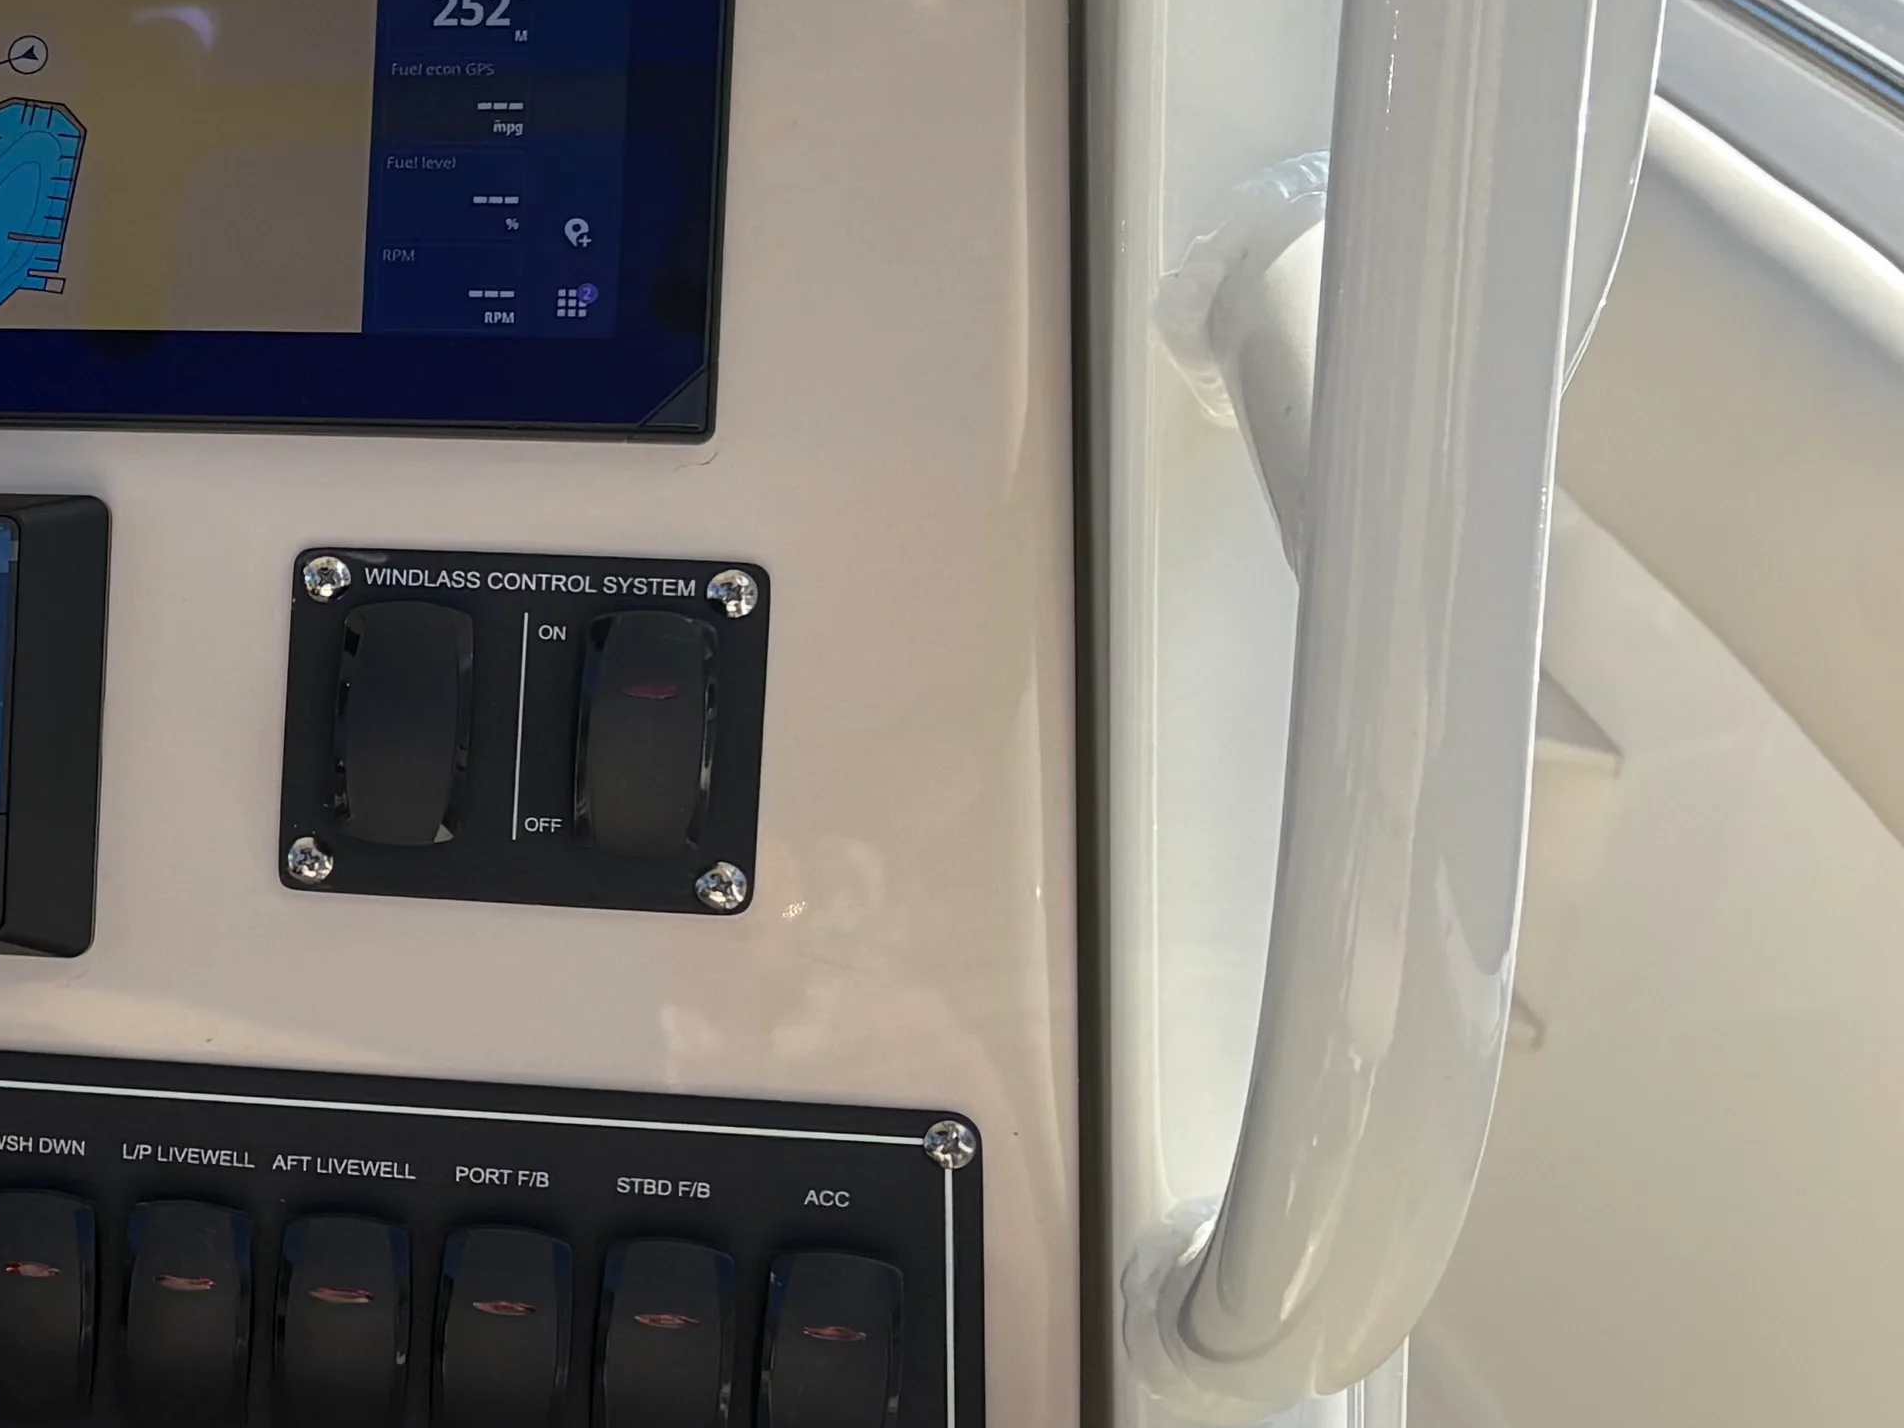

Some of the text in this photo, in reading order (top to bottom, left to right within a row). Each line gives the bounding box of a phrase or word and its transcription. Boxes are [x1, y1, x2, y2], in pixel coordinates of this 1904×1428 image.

[514, 29, 528, 42] M
[391, 61, 495, 78] Fuel econ GPS
[492, 122, 524, 137] mpg
[386, 155, 457, 170] Fuel level
[504, 216, 520, 231] %
[381, 248, 416, 262] RPM
[581, 286, 592, 301] 2
[483, 311, 515, 325] RPM
[365, 567, 696, 598] WINDLASS CONTROL SYSTEM
[538, 625, 566, 641] ON
[524, 816, 562, 834] OFF
[38, 1136, 86, 1156] DWN
[122, 1142, 255, 1169] L/P LIVEWELL
[272, 1153, 417, 1180] AFT LIVEWELL
[455, 1165, 549, 1188] PORT F/B
[616, 1176, 711, 1199] STBD F/B
[803, 1188, 850, 1208] ACC
